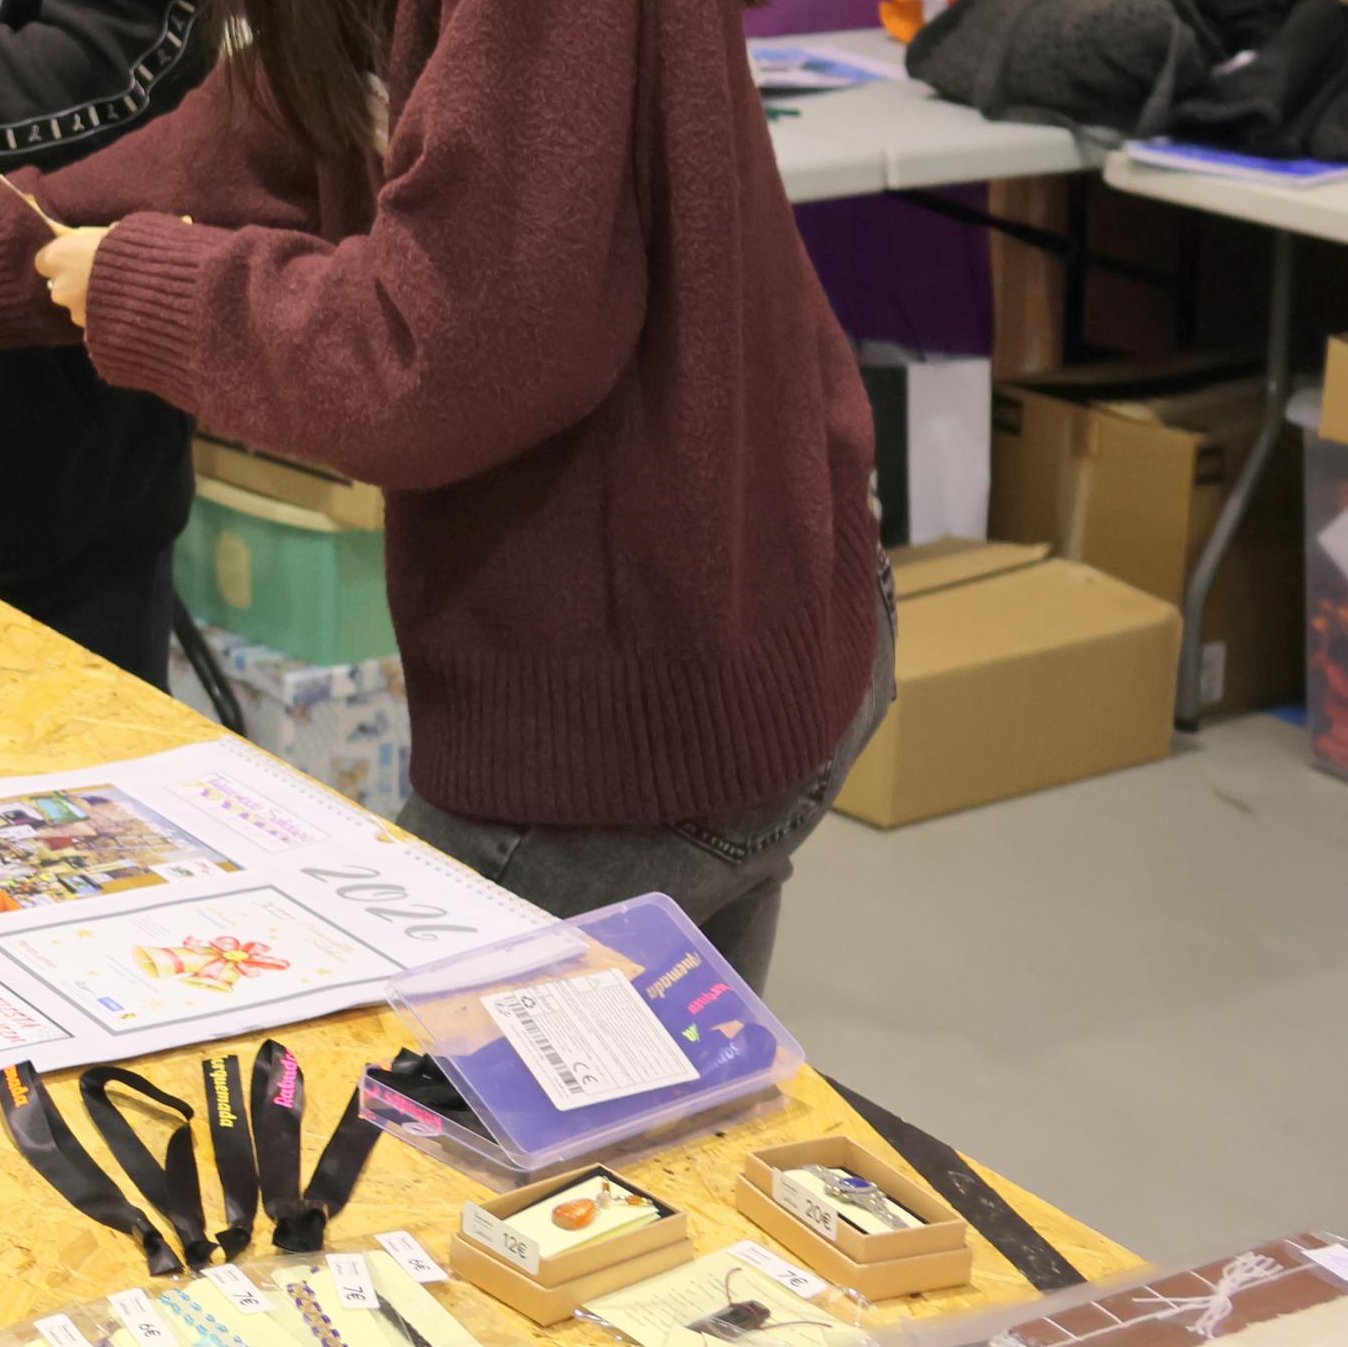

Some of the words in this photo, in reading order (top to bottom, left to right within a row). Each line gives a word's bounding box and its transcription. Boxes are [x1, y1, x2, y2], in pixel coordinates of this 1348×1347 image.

[300, 865, 479, 941] 2026
[804, 1203, 832, 1232] 20€
[503, 1232, 528, 1260] 12€
[775, 1270, 808, 1288] 7€
[232, 1291, 260, 1307] 7€
[343, 1285, 367, 1302] 7€
